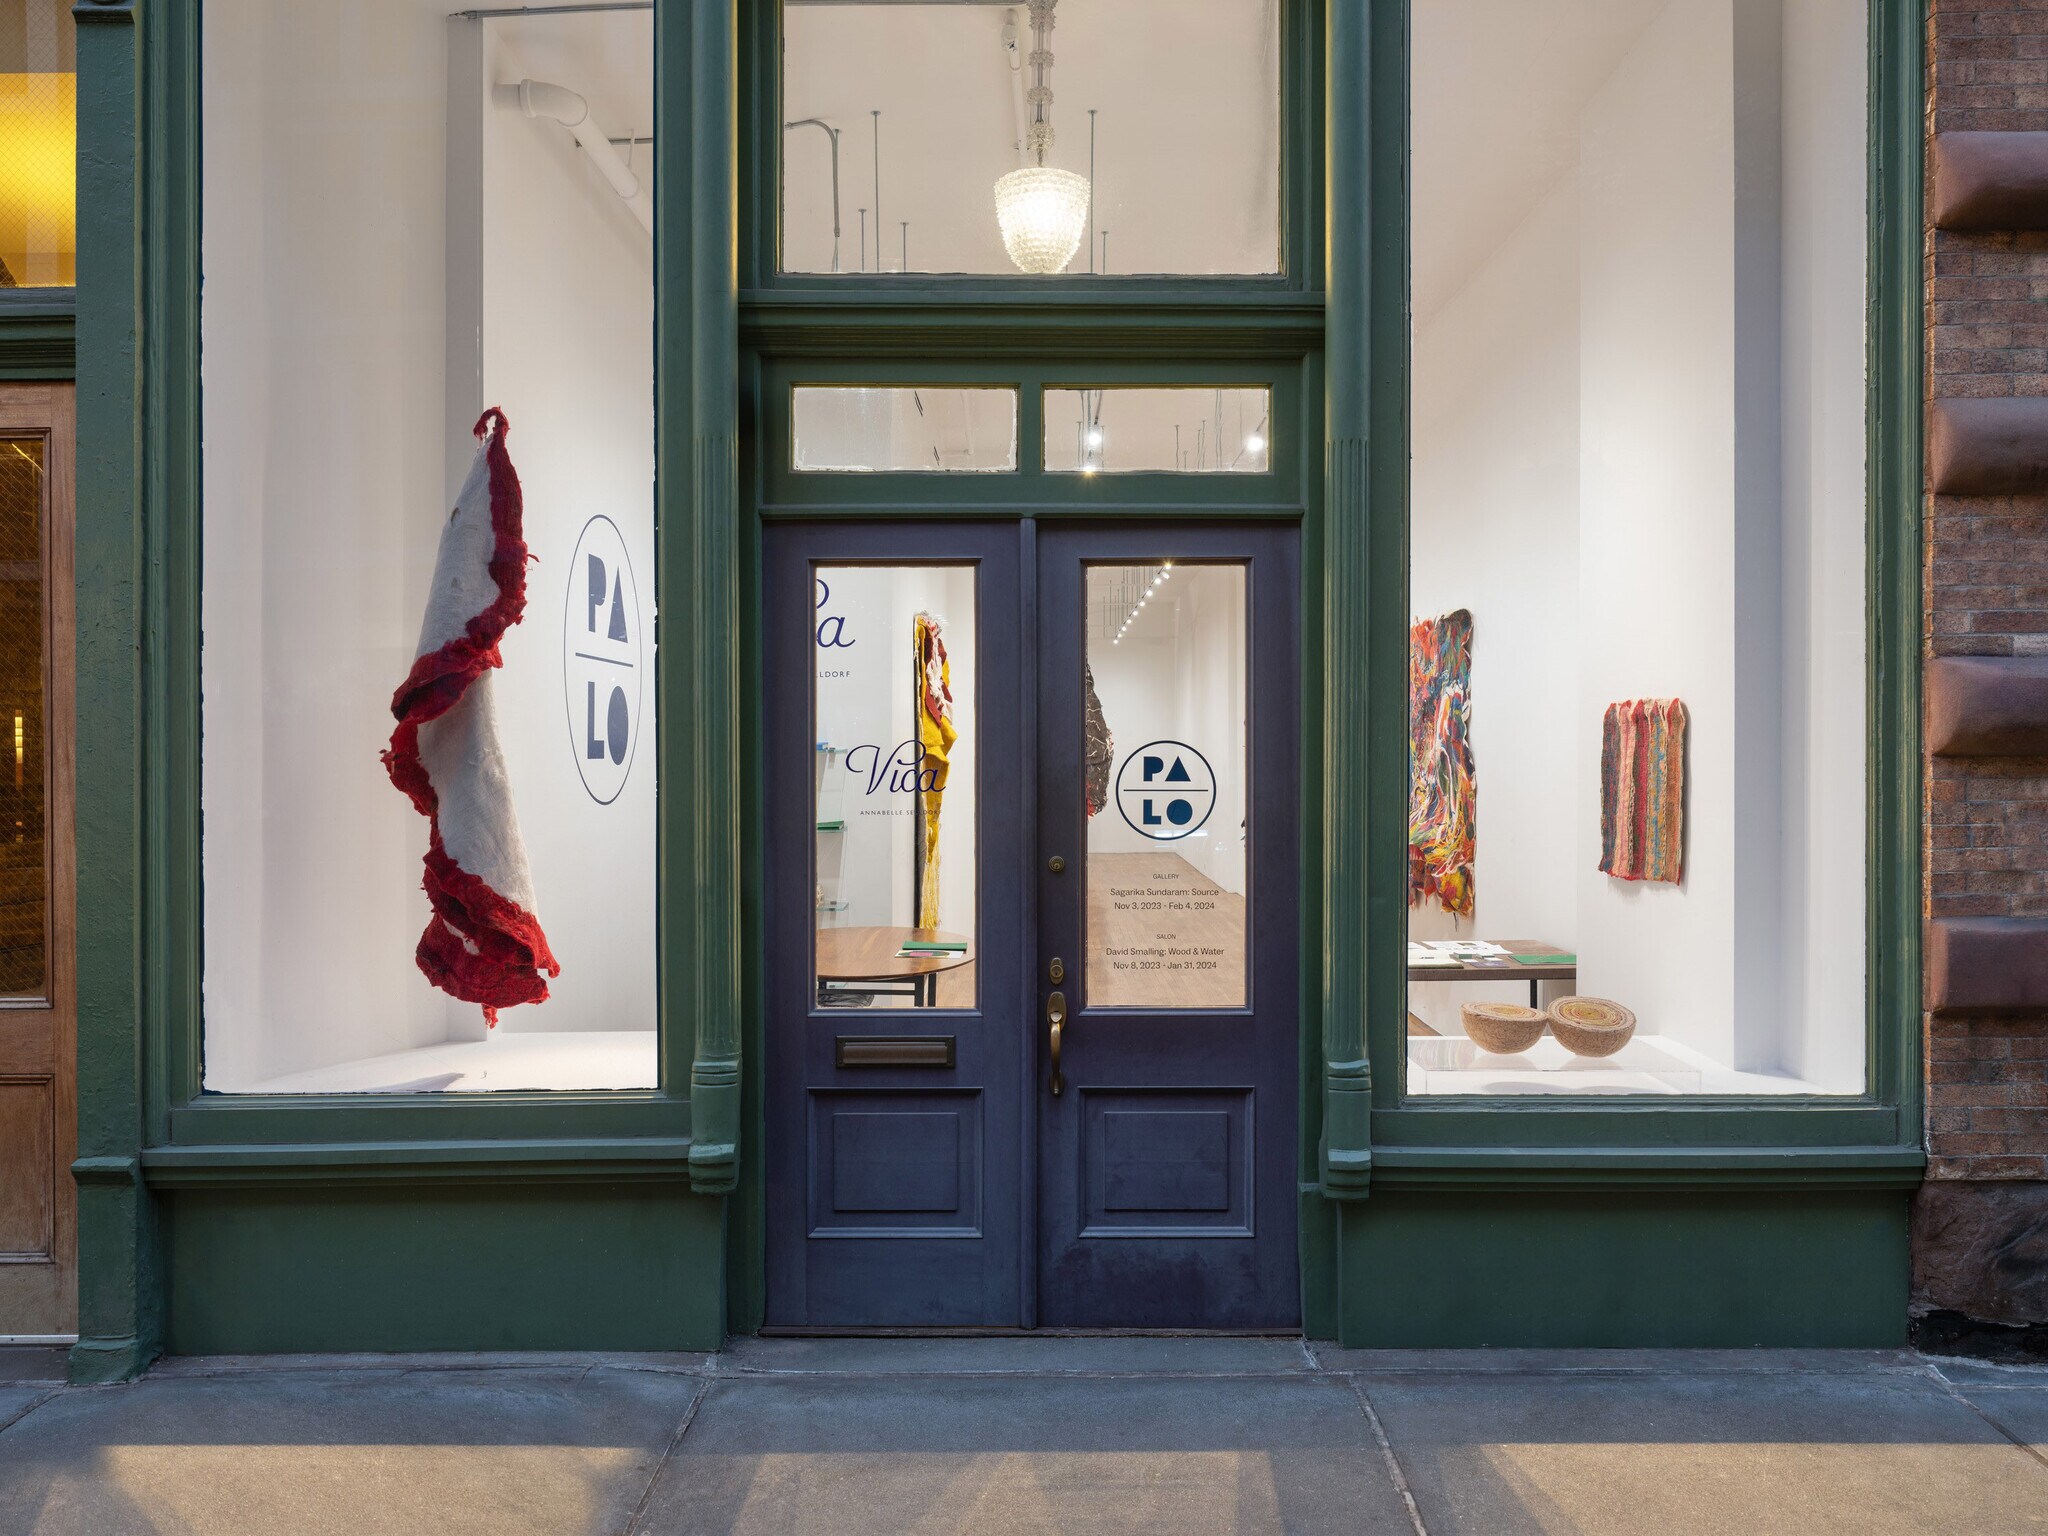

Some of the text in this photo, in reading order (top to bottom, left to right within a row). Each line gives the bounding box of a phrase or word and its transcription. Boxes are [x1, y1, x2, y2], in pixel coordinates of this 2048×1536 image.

[588, 553, 628, 643] PA
[587, 681, 629, 765] LO
[845, 739, 946, 795] Vica
[1143, 756, 1191, 782] PA
[1143, 799, 1193, 825] LO
[1110, 888, 1219, 897] Sagarika Sundaram: Source
[1114, 902, 1130, 910] Nov
[1131, 902, 1139, 911] 3,
[1140, 902, 1161, 910] 2023
[1168, 902, 1184, 910] Feb
[1185, 902, 1193, 911] 4,
[1194, 902, 1215, 910] 2024
[1130, 948, 1167, 957] Smalling:
[1130, 962, 1138, 970] 8,
[1184, 962, 1195, 970] 31,
